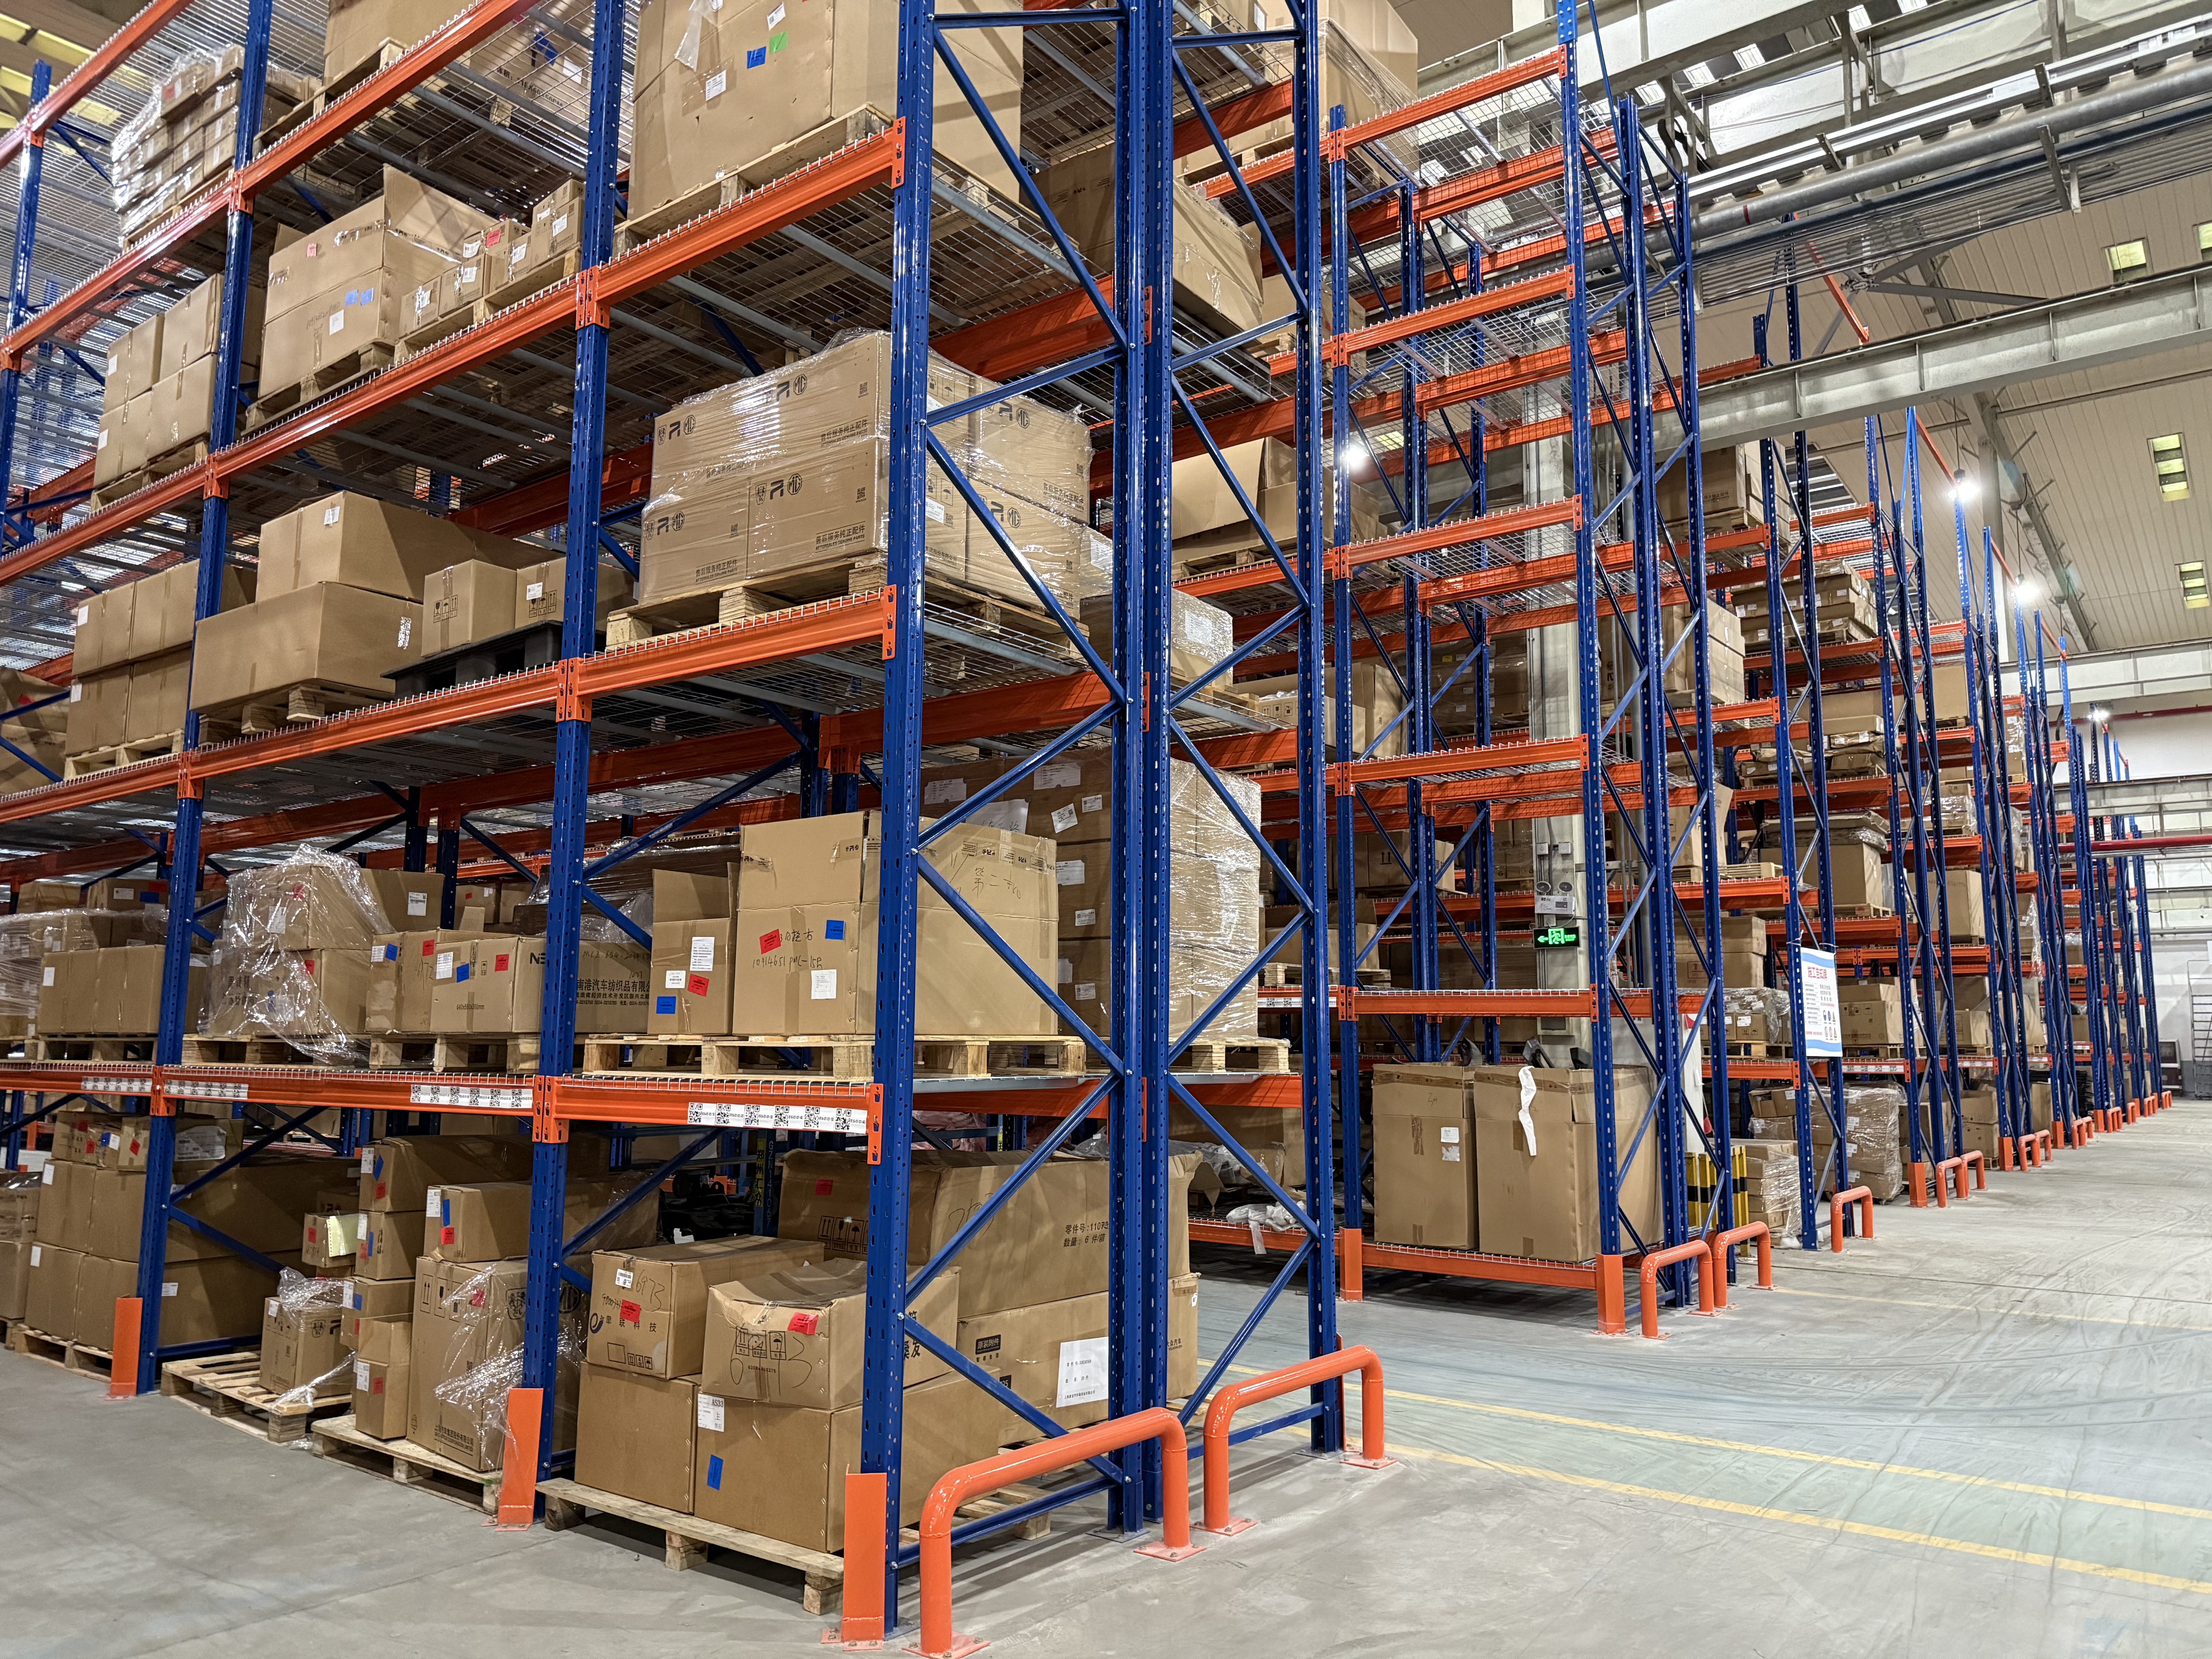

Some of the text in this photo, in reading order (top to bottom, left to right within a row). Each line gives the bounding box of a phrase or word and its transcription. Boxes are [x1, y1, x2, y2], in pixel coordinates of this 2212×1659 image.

[794, 376, 806, 393] MG
[684, 417, 695, 433] MG
[1017, 409, 1029, 427] MG
[788, 476, 802, 493] MG
[673, 512, 684, 529] MG
[1008, 508, 1020, 527] MG
[816, 524, 865, 544] 售后服务纯正配件
[696, 558, 737, 577] 售后服务纯正配件
[755, 1149, 764, 1206] 郑州汇众
[977, 1338, 1000, 1349] 原装附件
[711, 1398, 724, 1408] AS33
